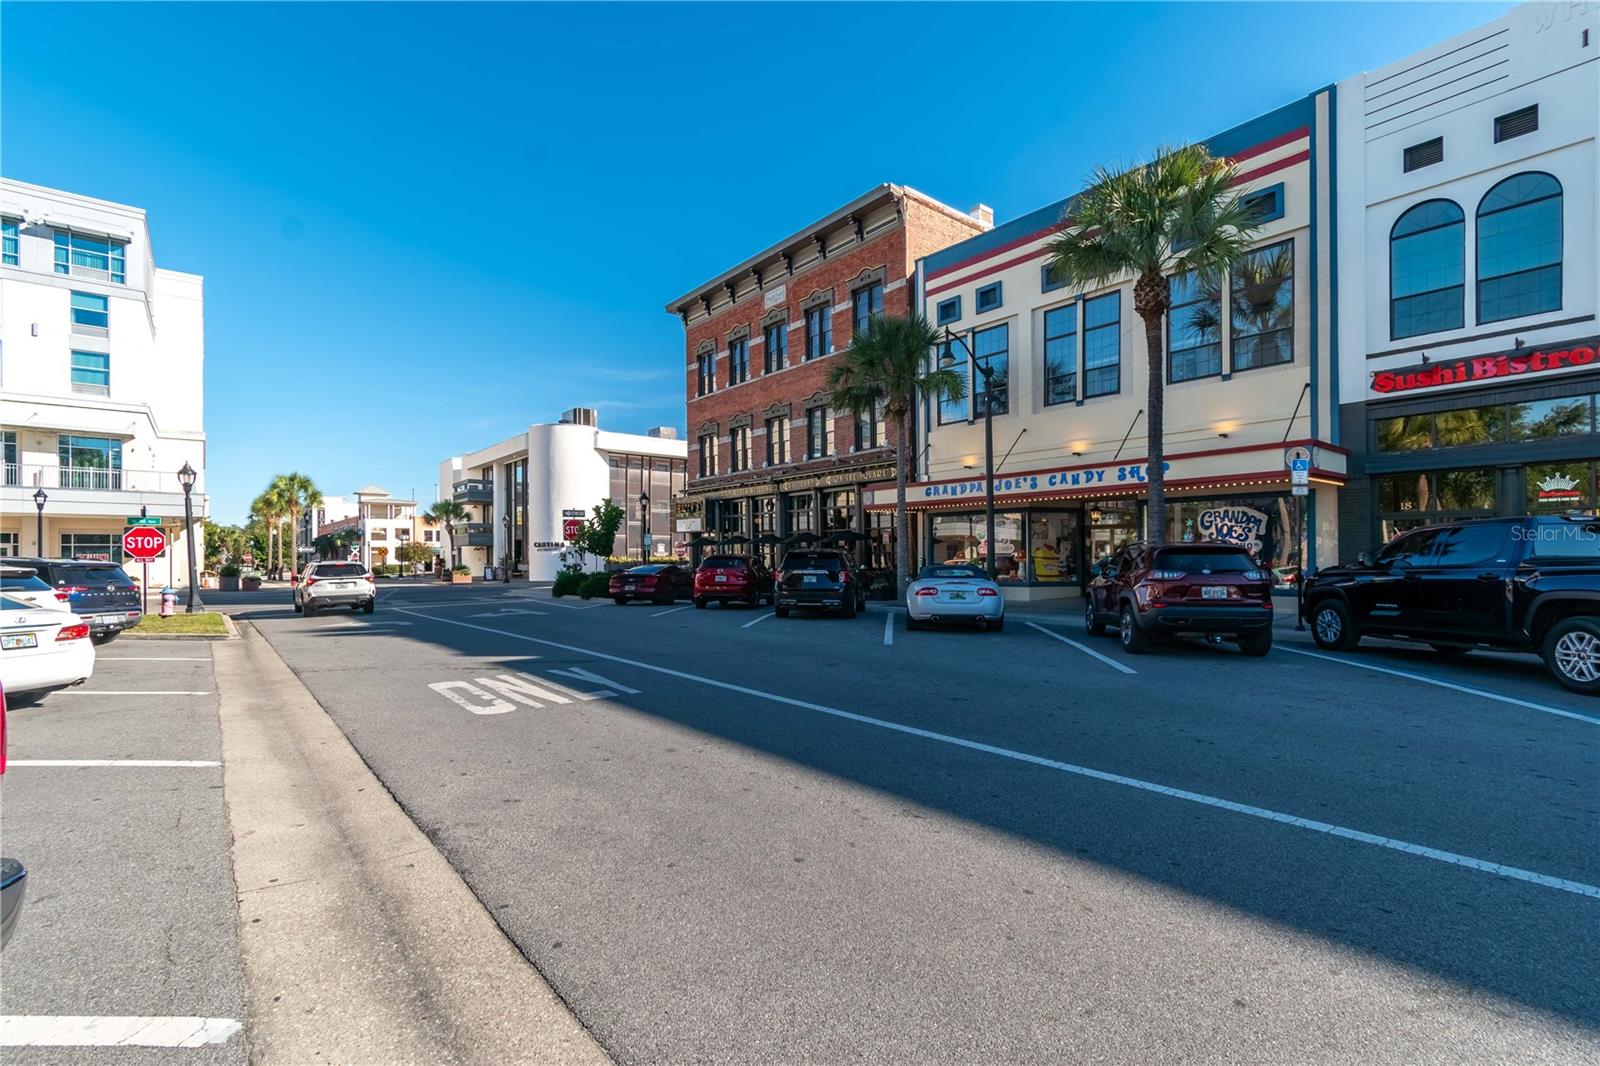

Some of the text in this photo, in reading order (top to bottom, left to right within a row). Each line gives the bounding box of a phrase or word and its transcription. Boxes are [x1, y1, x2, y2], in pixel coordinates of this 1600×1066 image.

[1374, 347, 1594, 393] Sushi Bistro
[925, 462, 1170, 497] GRANDPA JOE'S CANDY SHP
[565, 525, 580, 535] STO
[1200, 510, 1262, 533] GRANDPA
[1208, 523, 1252, 542] JOE'S
[126, 536, 163, 549] STOP
[427, 666, 642, 715] ONLY
